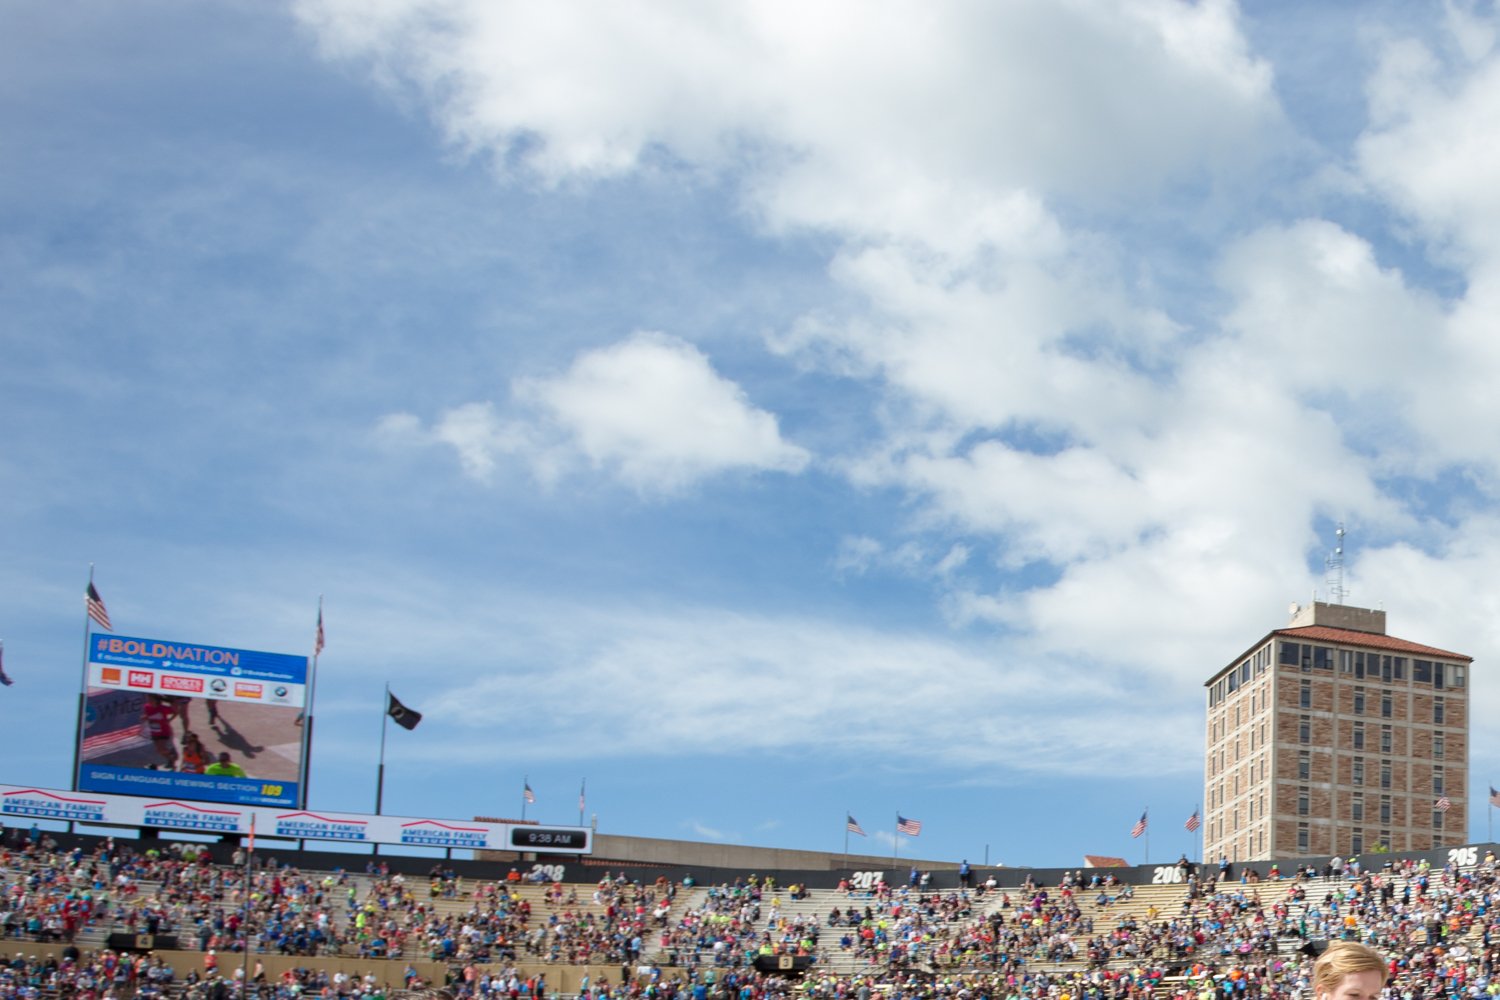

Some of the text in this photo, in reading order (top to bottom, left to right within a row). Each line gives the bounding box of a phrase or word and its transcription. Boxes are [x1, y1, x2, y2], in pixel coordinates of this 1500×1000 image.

[97, 638, 240, 666] #BOLDNATION
[91, 772, 283, 796] SIGN LANGUAGE VIEWING SECTION 109
[4, 798, 105, 813] AMERICAN FAMILY
[10, 806, 97, 820] INSURANCE
[145, 811, 239, 823] AMERICAN FAMILY
[153, 818, 233, 831] INSURANCE
[277, 820, 366, 832] AMERICAN FAMILY
[284, 828, 359, 840] INSURANCE
[401, 828, 489, 840] AMERICAN FAMILY
[528, 833, 572, 844] 9:38 AM
[408, 837, 481, 847] INSURANCE
[1447, 847, 1478, 866] 205
[852, 871, 884, 888] 207
